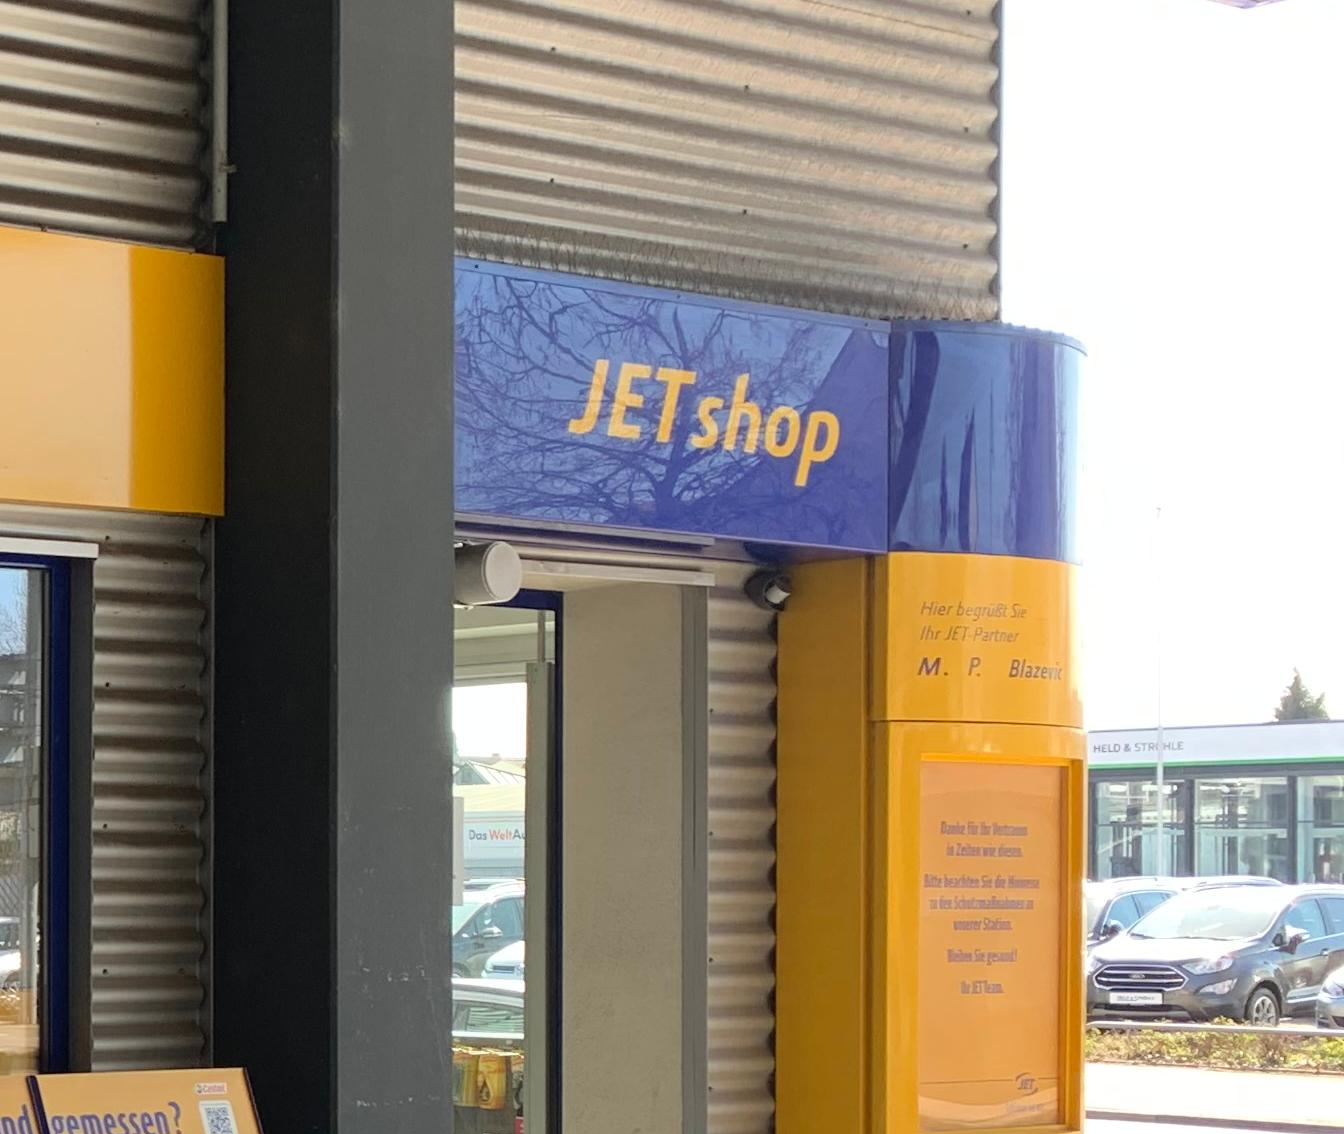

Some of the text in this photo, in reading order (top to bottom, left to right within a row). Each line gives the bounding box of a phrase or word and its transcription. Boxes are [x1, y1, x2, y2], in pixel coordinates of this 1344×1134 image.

[568, 359, 840, 487] JET shop
[920, 601, 1028, 621] Hier begrüßt Sie
[920, 625, 941, 641] Ihr
[917, 657, 949, 676] M.
[968, 657, 981, 676] P.
[1093, 743, 1121, 753] HELD
[1123, 743, 1132, 752] &
[468, 829, 487, 841] Das
